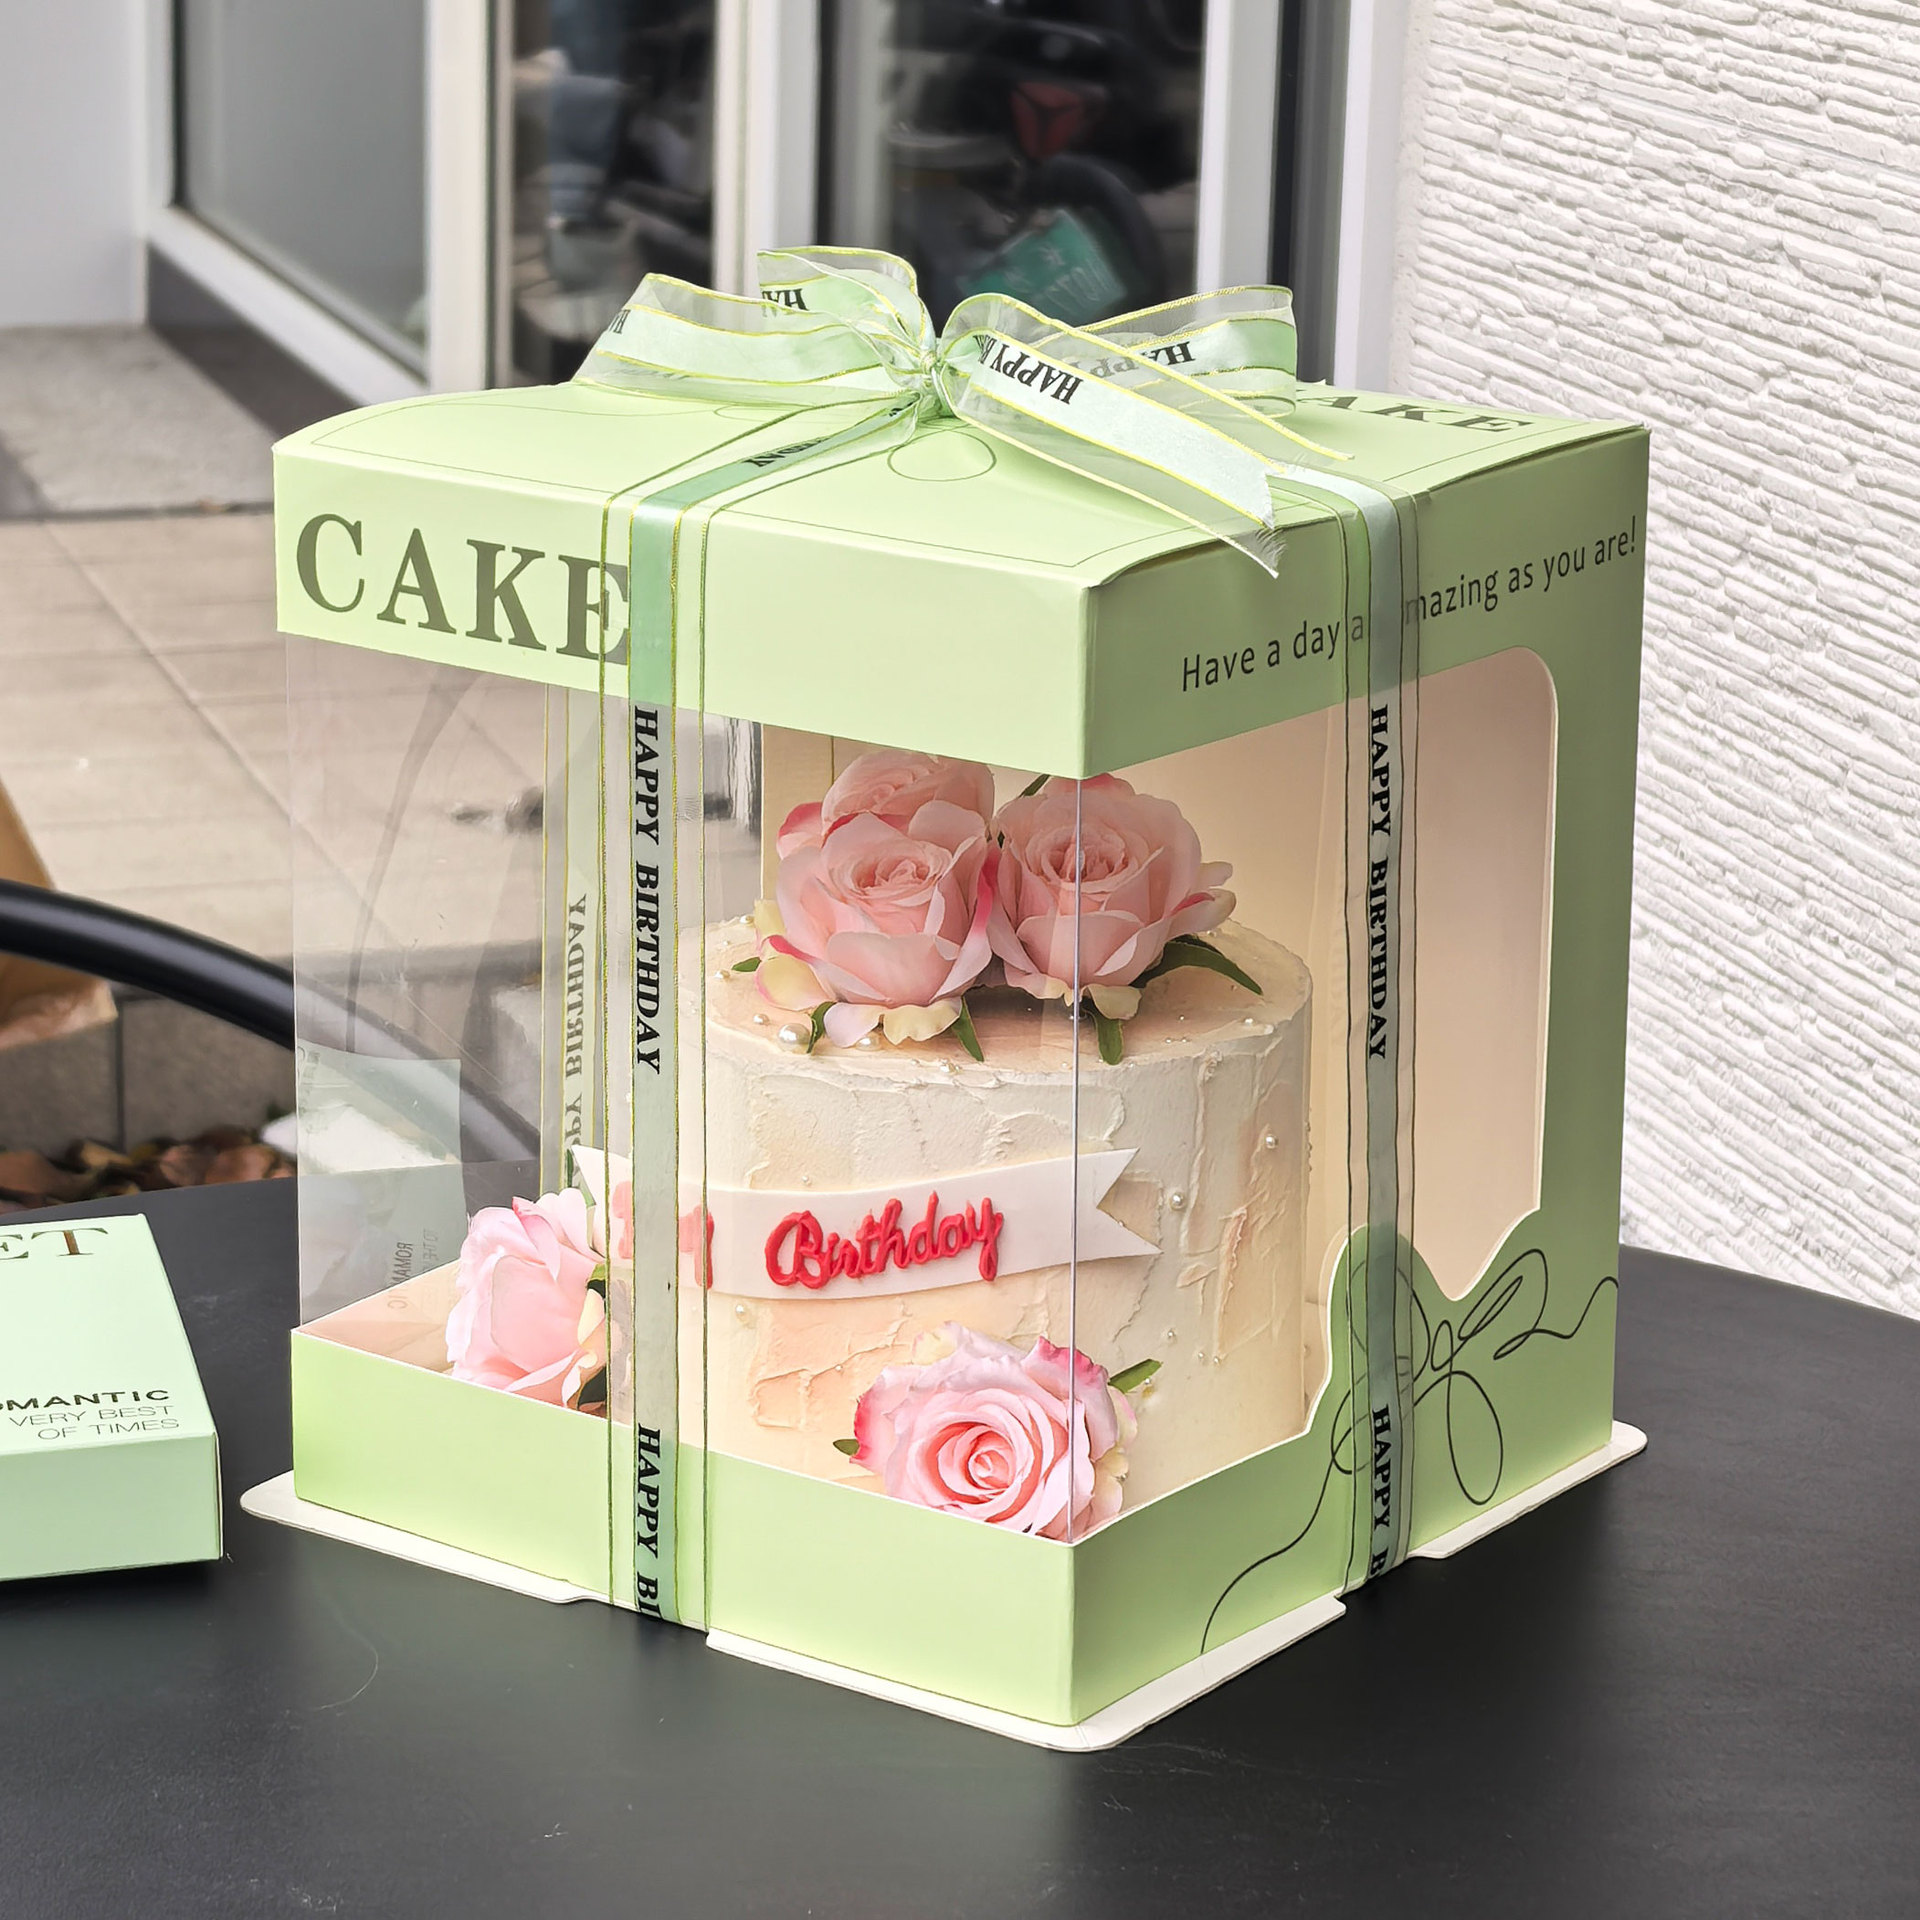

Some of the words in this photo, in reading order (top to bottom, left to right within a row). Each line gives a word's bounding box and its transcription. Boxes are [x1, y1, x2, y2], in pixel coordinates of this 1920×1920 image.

[989, 342, 1084, 405] HAPPY
[1296, 394, 1535, 433] AKE
[296, 513, 630, 666] CAKE
[1182, 647, 1255, 692] Have
[1266, 639, 1281, 668] a
[1293, 619, 1340, 660] day
[1405, 569, 1499, 624] mazing
[1508, 562, 1534, 593] as
[1543, 546, 1586, 592] you
[1594, 515, 1636, 566] are!
[634, 704, 661, 846] HAPPY
[1370, 703, 1391, 837] HAPPY
[635, 859, 661, 1075] BIRTHDAY
[1368, 855, 1388, 1060] BIRTHDAY
[764, 1190, 1004, 1290] Birthday
[9, 1411, 87, 1427] VERY
[98, 1405, 175, 1420] BEST
[38, 1426, 78, 1441] OF
[89, 1418, 180, 1436] TIMES
[1372, 1403, 1392, 1531] HAPPY
[637, 1422, 661, 1559] HAPPY
